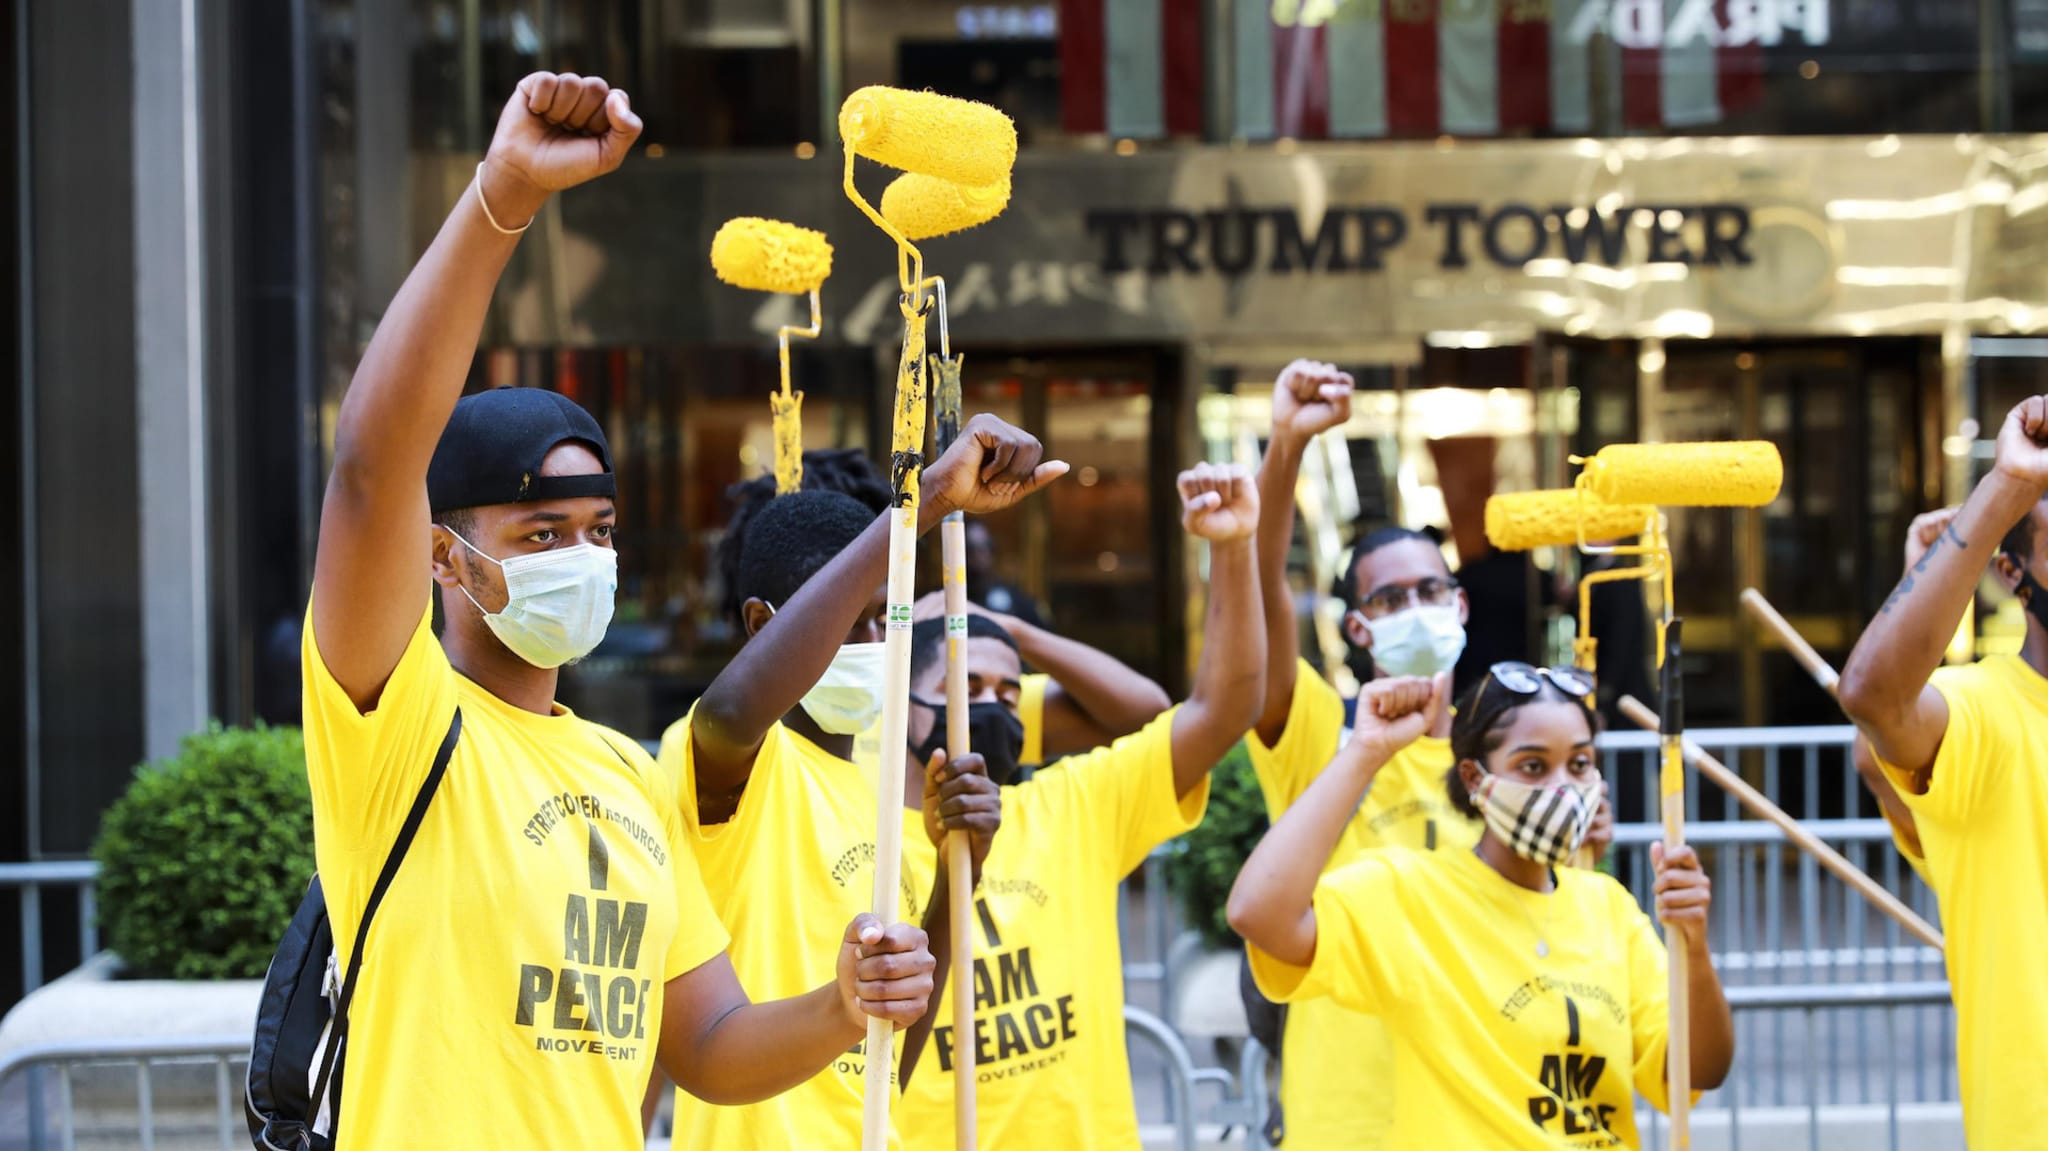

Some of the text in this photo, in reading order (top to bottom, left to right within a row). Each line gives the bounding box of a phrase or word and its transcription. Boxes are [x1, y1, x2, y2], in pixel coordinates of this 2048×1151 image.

[1086, 205, 1753, 273] TRUMP TOWER
[588, 821, 608, 891] I
[1425, 819, 1437, 851] I
[564, 893, 648, 970] AM
[976, 898, 1002, 947] I
[974, 947, 1039, 1011] AM
[1566, 996, 1580, 1046] I
[978, 1051, 1067, 1083] OVEMENT
[1539, 1054, 1606, 1102] AM
